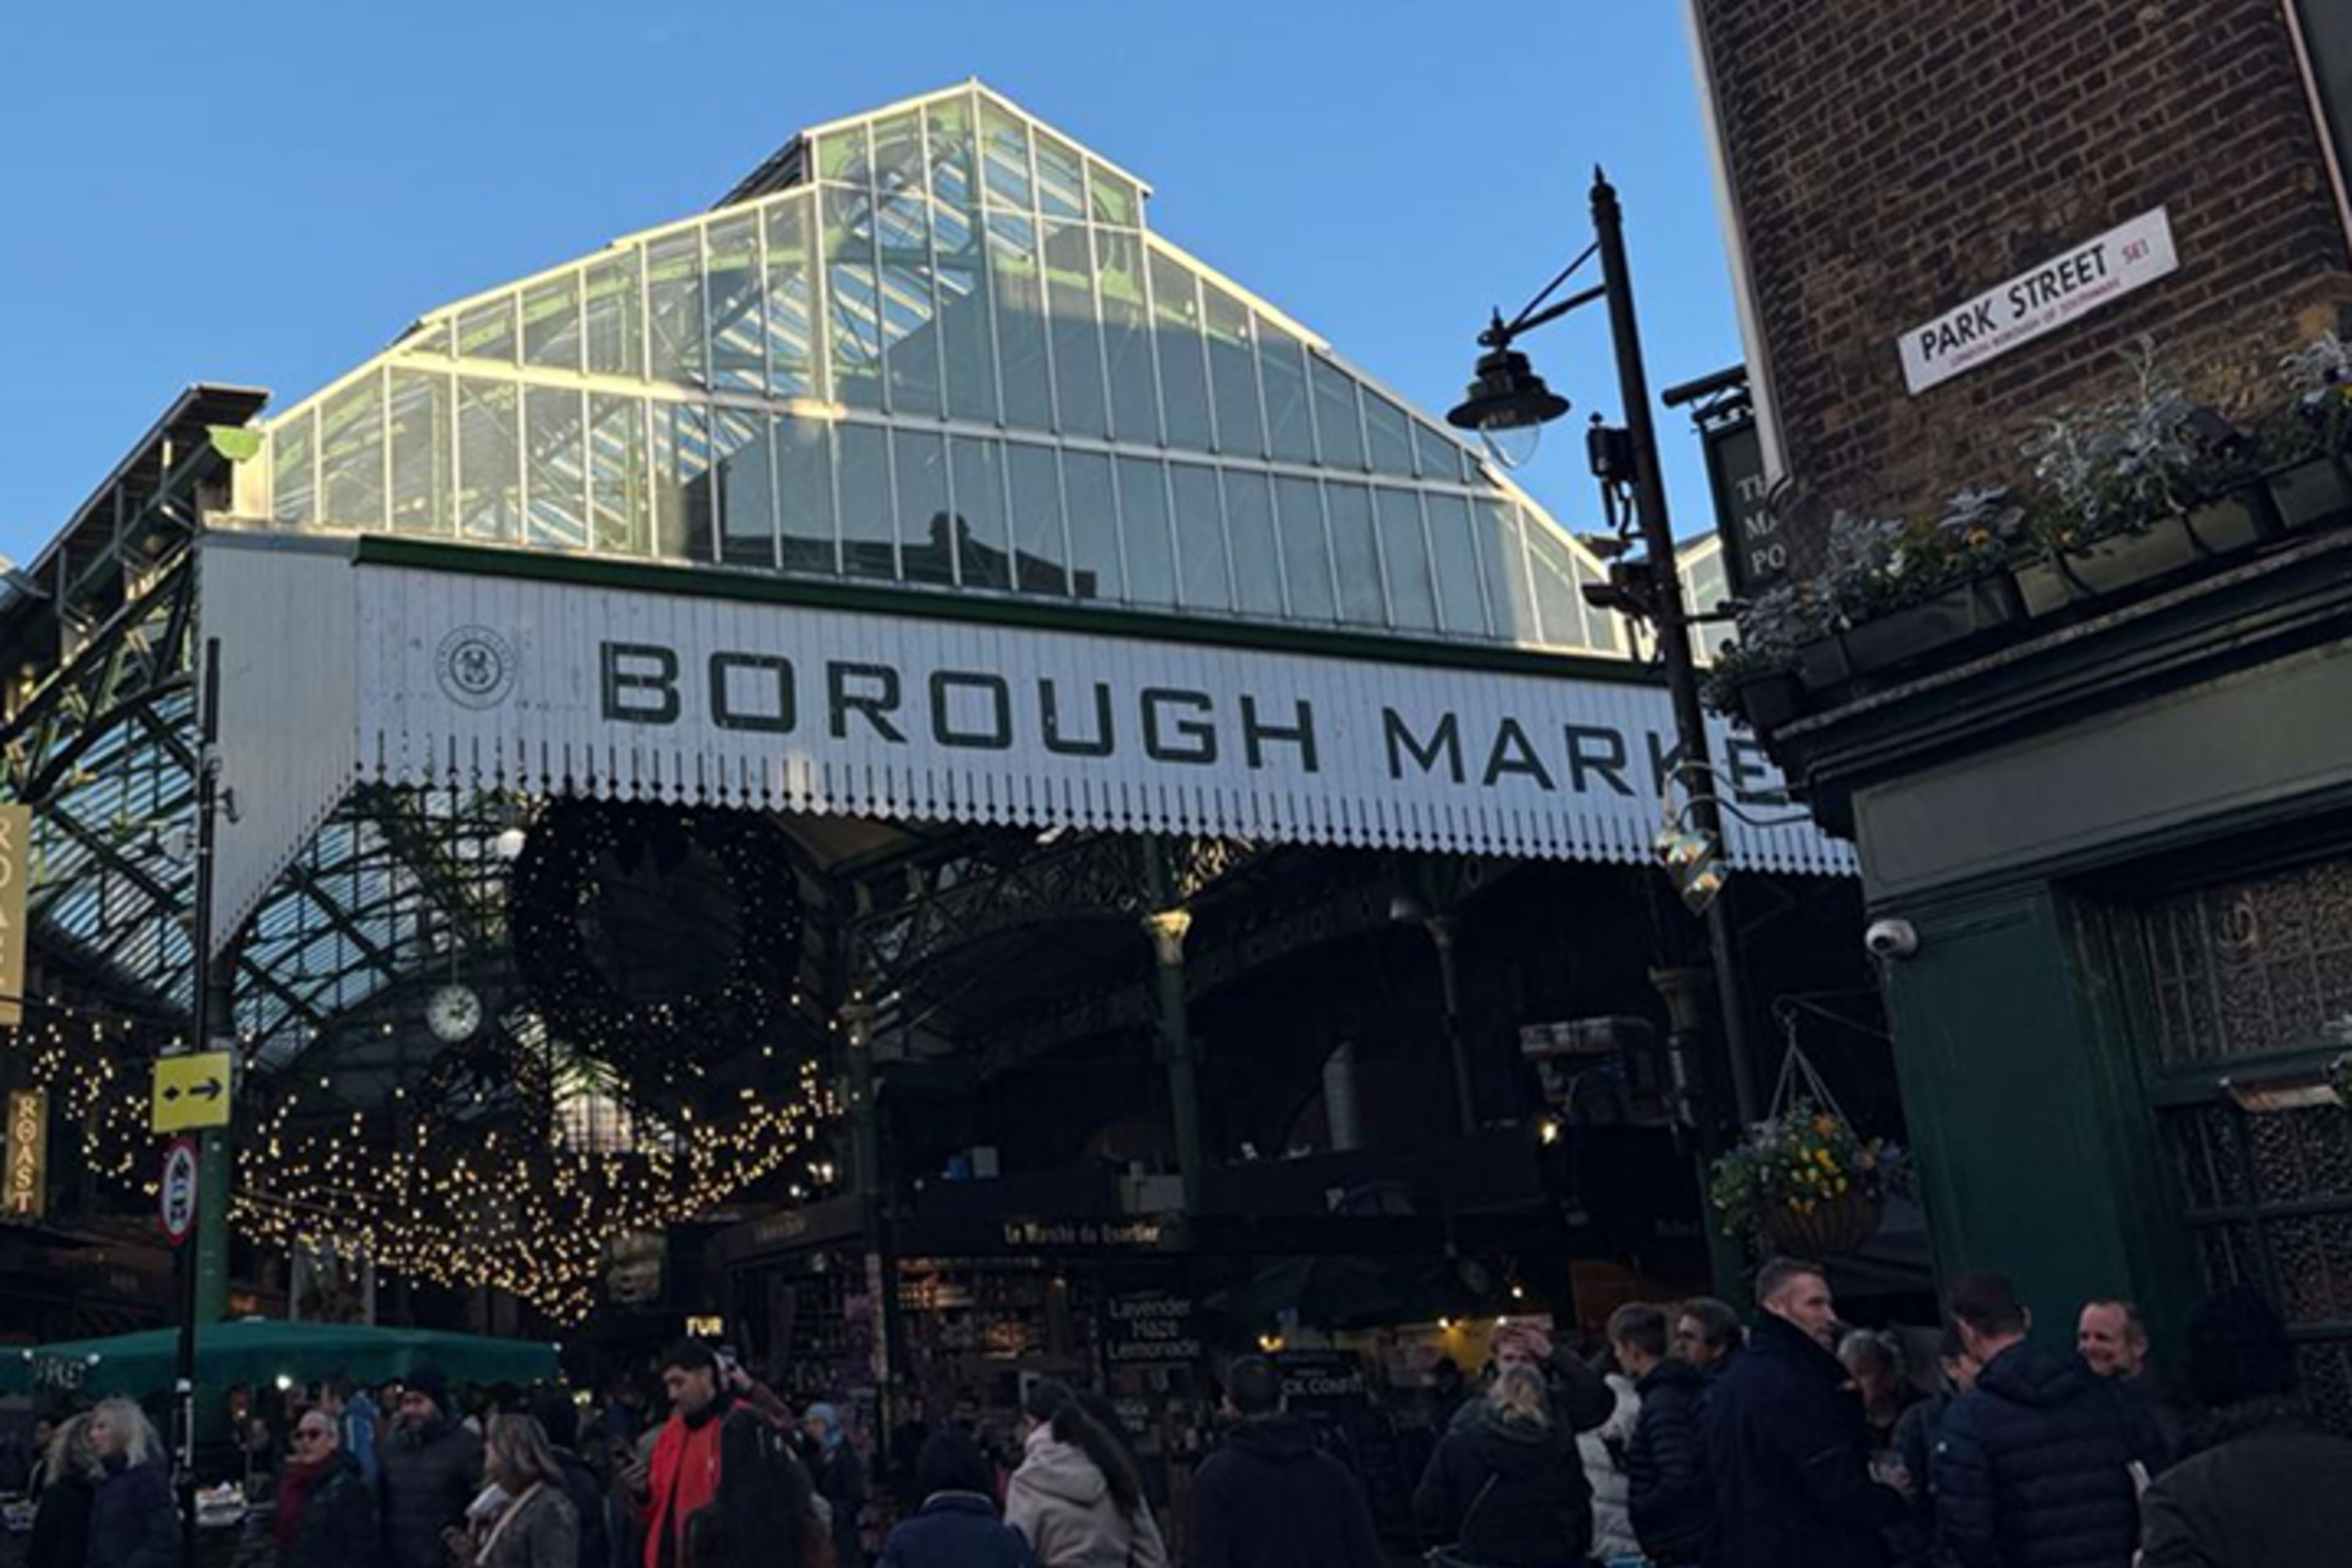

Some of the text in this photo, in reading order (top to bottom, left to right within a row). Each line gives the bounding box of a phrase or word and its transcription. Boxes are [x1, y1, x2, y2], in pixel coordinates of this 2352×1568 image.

[1920, 299, 1997, 361] PARK
[2007, 244, 2108, 318] STREET
[2121, 238, 2150, 265] SE1
[598, 641, 1319, 774] BOROUGH
[14, 1095, 37, 1213] ROAST
